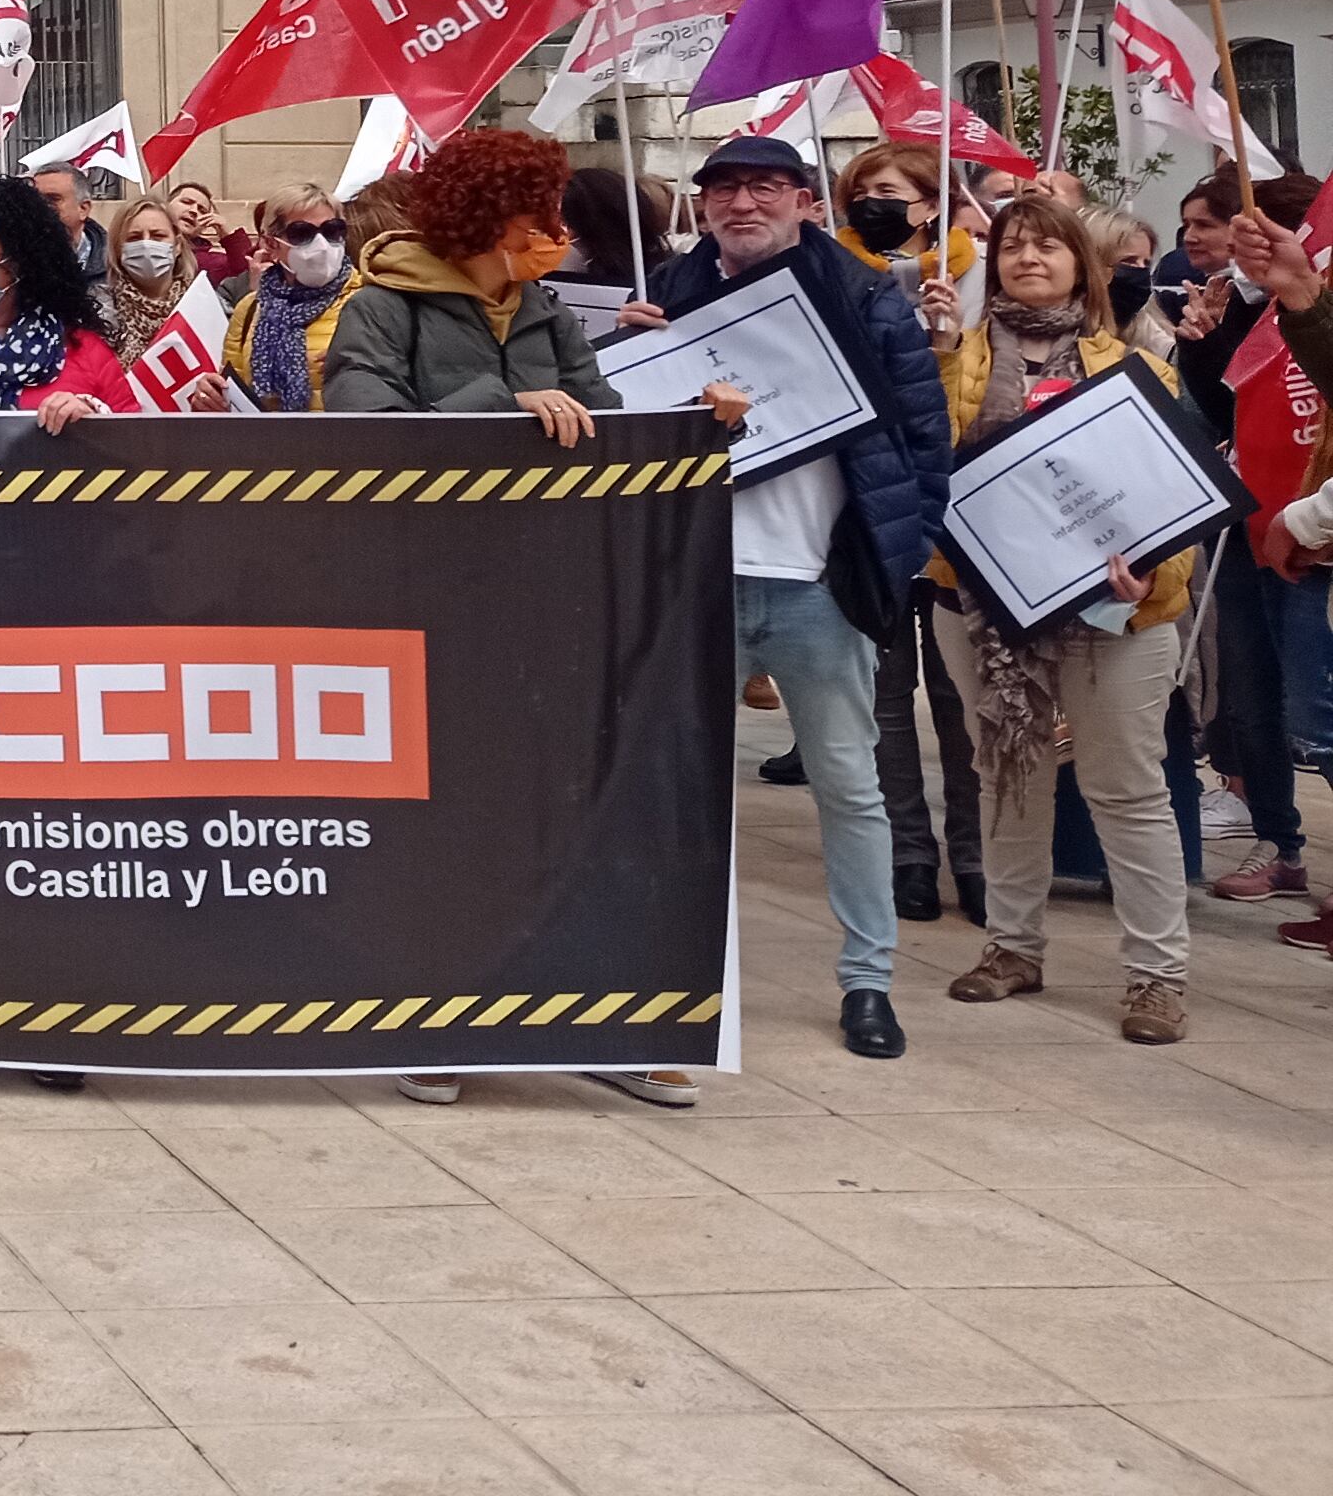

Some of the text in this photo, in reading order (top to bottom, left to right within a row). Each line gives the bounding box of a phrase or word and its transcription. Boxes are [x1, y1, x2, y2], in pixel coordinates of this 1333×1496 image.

[1085, 489, 1127, 520] Cerebral
[202, 809, 372, 849] obreras
[4, 859, 171, 899] Castilla
[181, 869, 209, 909] y
[221, 858, 328, 897] León
